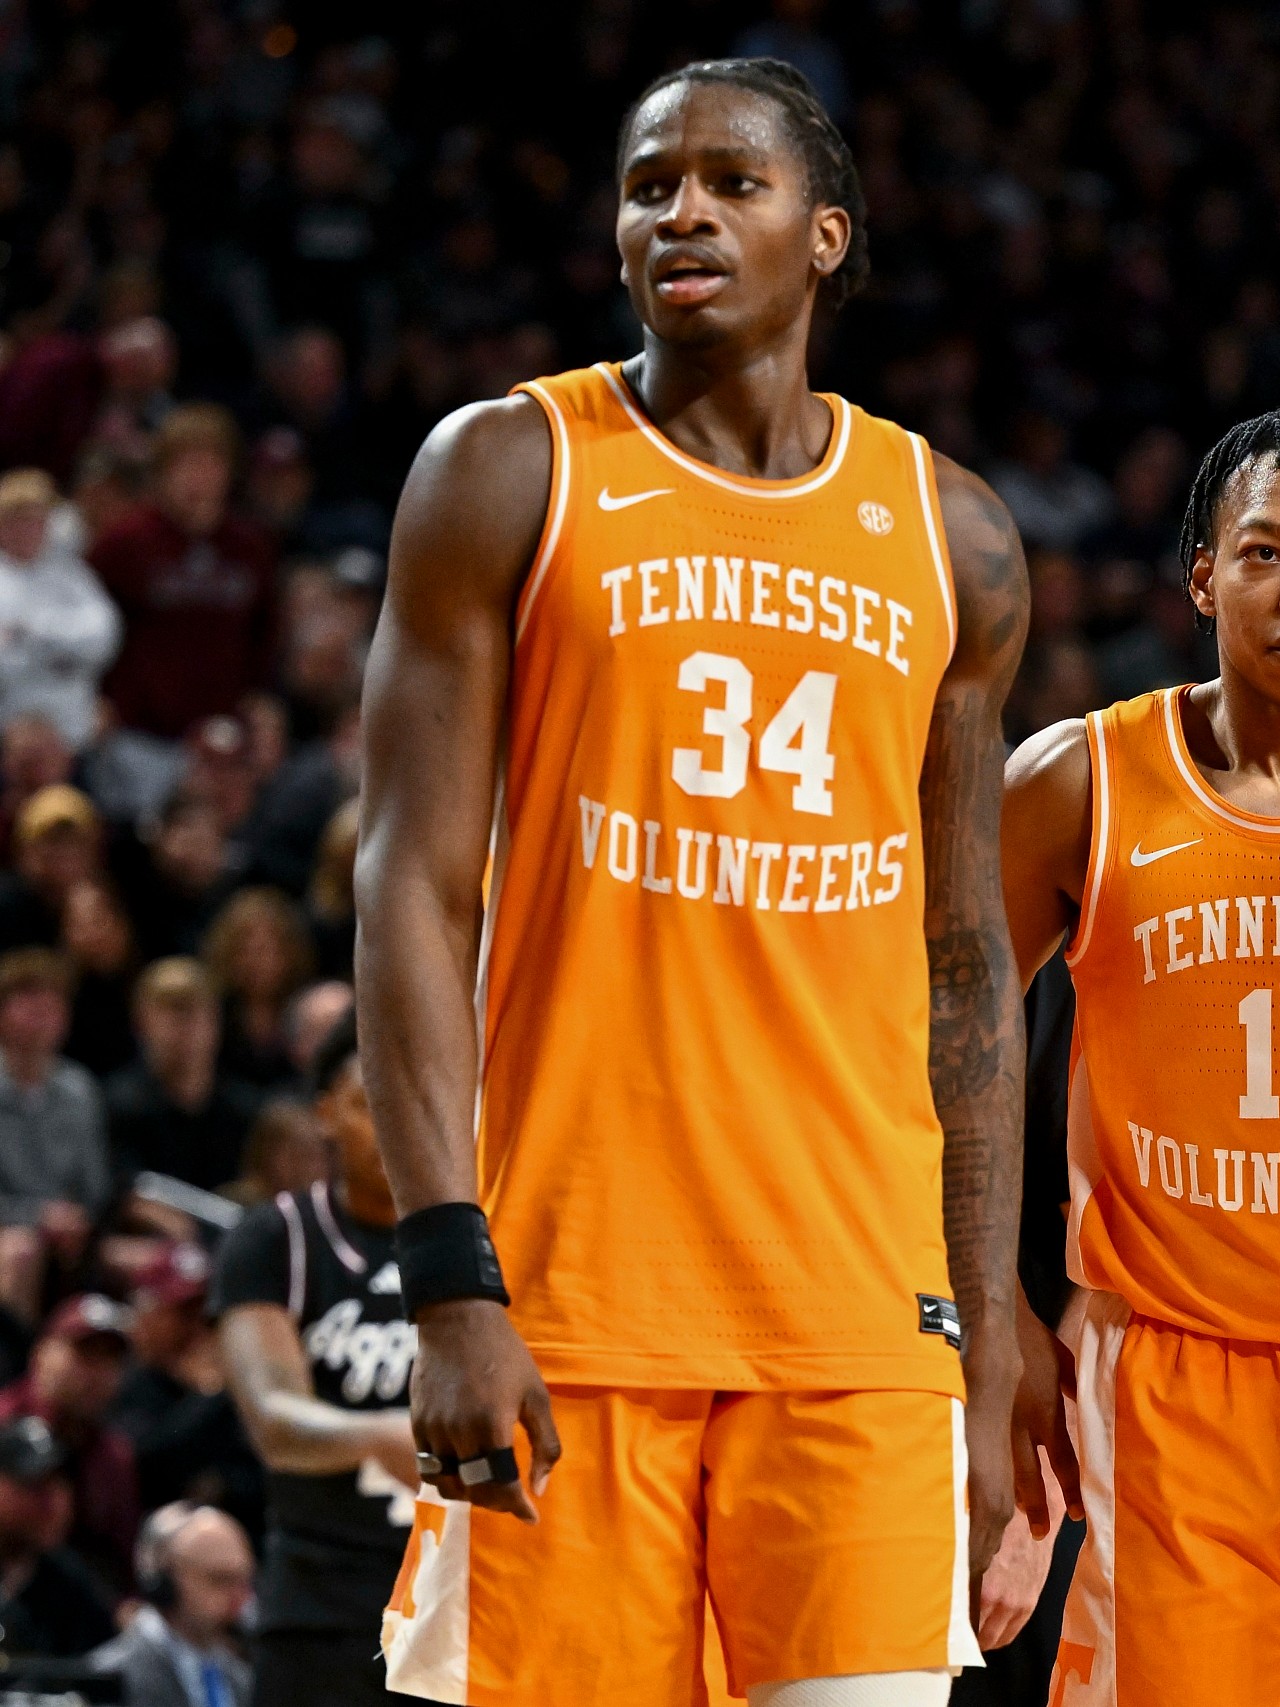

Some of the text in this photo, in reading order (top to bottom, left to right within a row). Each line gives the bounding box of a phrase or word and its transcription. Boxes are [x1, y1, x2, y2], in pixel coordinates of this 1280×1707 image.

[861, 503, 891, 532] SEC
[601, 555, 913, 677] TENNESSEE
[671, 650, 838, 817] 34
[578, 795, 909, 913] VOLUNTEERS
[304, 1299, 419, 1402] Agg
